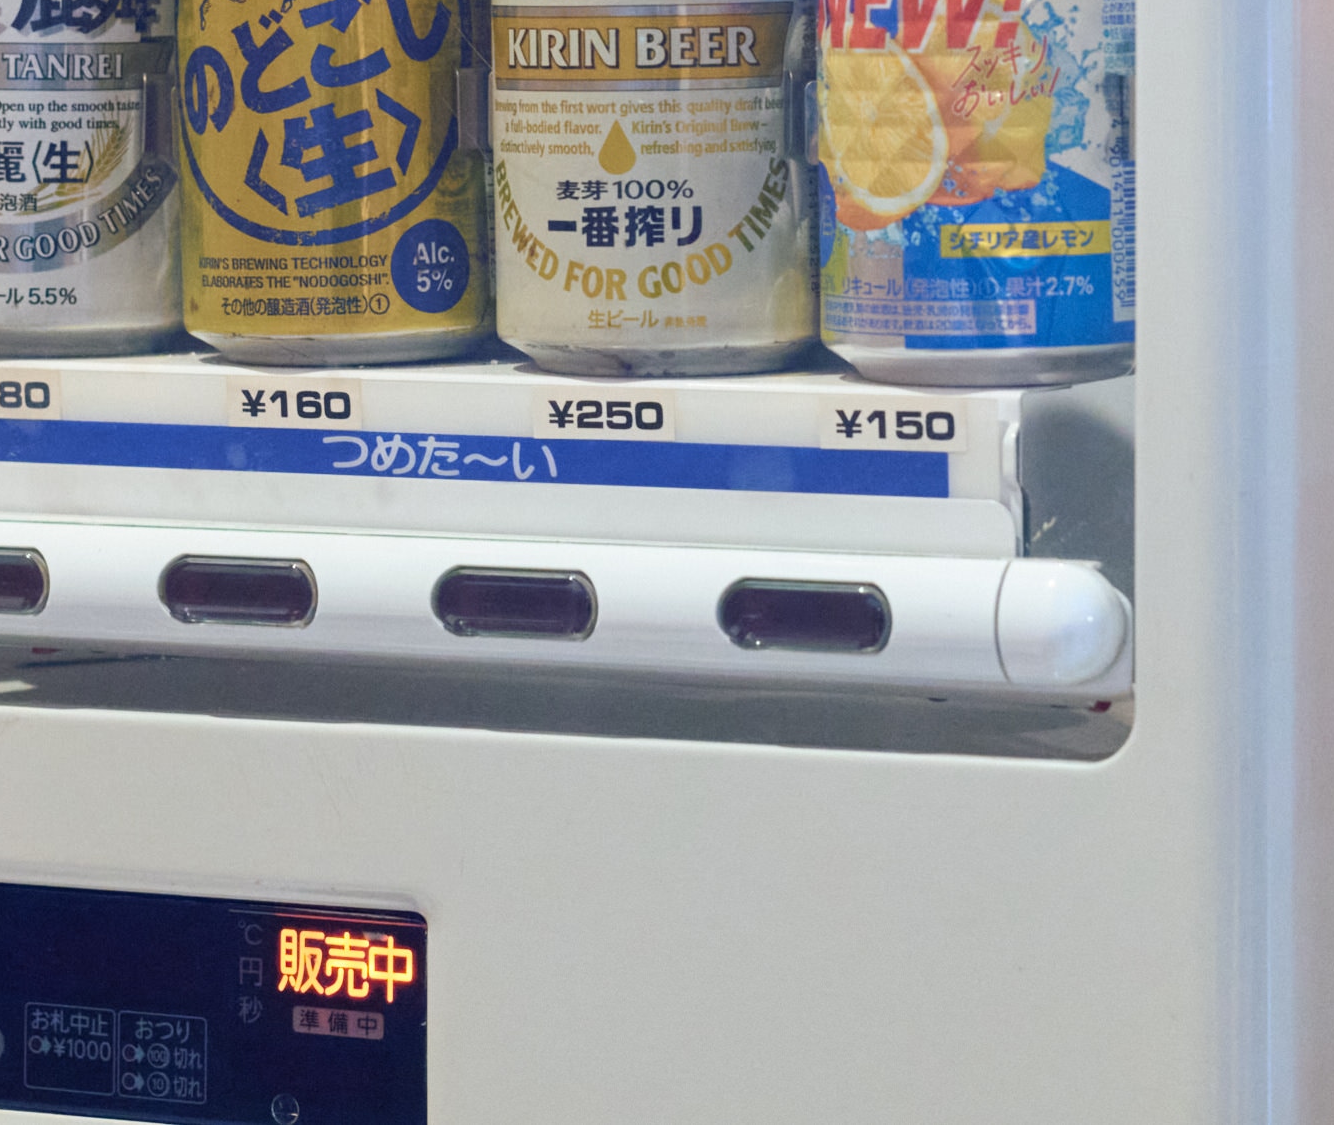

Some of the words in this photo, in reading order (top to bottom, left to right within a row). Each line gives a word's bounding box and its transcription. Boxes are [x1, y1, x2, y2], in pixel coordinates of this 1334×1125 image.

[507, 27, 619, 69] KIRIN
[635, 26, 760, 68] BEER
[2, 53, 124, 80] TANREI
[951, 35, 1047, 88] スッキリ
[28, 102, 45, 115] up
[48, 100, 67, 112] the
[71, 100, 114, 112] smooth
[519, 99, 538, 113] from
[542, 99, 557, 113] the
[560, 100, 583, 114] first
[587, 102, 616, 114] wort
[620, 100, 654, 117] gives
[658, 99, 681, 113] this
[687, 98, 731, 115] quality
[734, 96, 762, 111] draft
[19, 117, 46, 129] with
[51, 117, 82, 133] good
[511, 119, 560, 134] full-bodied
[564, 120, 602, 134] flavor.
[632, 120, 672, 134] Kirin's
[675, 119, 727, 136] Original
[548, 141, 595, 156] smooth,
[640, 140, 702, 156] refreshing
[705, 139, 727, 153] and
[13, 221, 100, 261] GOOD
[99, 168, 163, 234] TIMES
[547, 205, 703, 247] 一番搾り
[494, 159, 559, 281] BREWED
[563, 260, 627, 300] FOR
[637, 243, 733, 298] GOOD
[728, 156, 789, 252] TIMES
[949, 229, 1095, 250] シチリア産レモン
[232, 258, 288, 270] BREWING
[291, 255, 388, 270] TECHNOLOGY
[413, 242, 455, 266] Alc.
[268, 276, 291, 288] THE
[416, 269, 453, 293] 5%
[588, 309, 659, 329] 生ビール
[242, 389, 352, 420] ¥160
[548, 399, 664, 431] ¥250
[836, 409, 955, 441] ¥150
[239, 956, 263, 987] 円
[278, 928, 413, 1003] 販売中
[31, 1008, 109, 1037] お札中止
[238, 996, 263, 1024] 秒
[299, 1009, 378, 1036] 準備中
[135, 1018, 190, 1043] おつり
[53, 1039, 111, 1062] ¥1000
